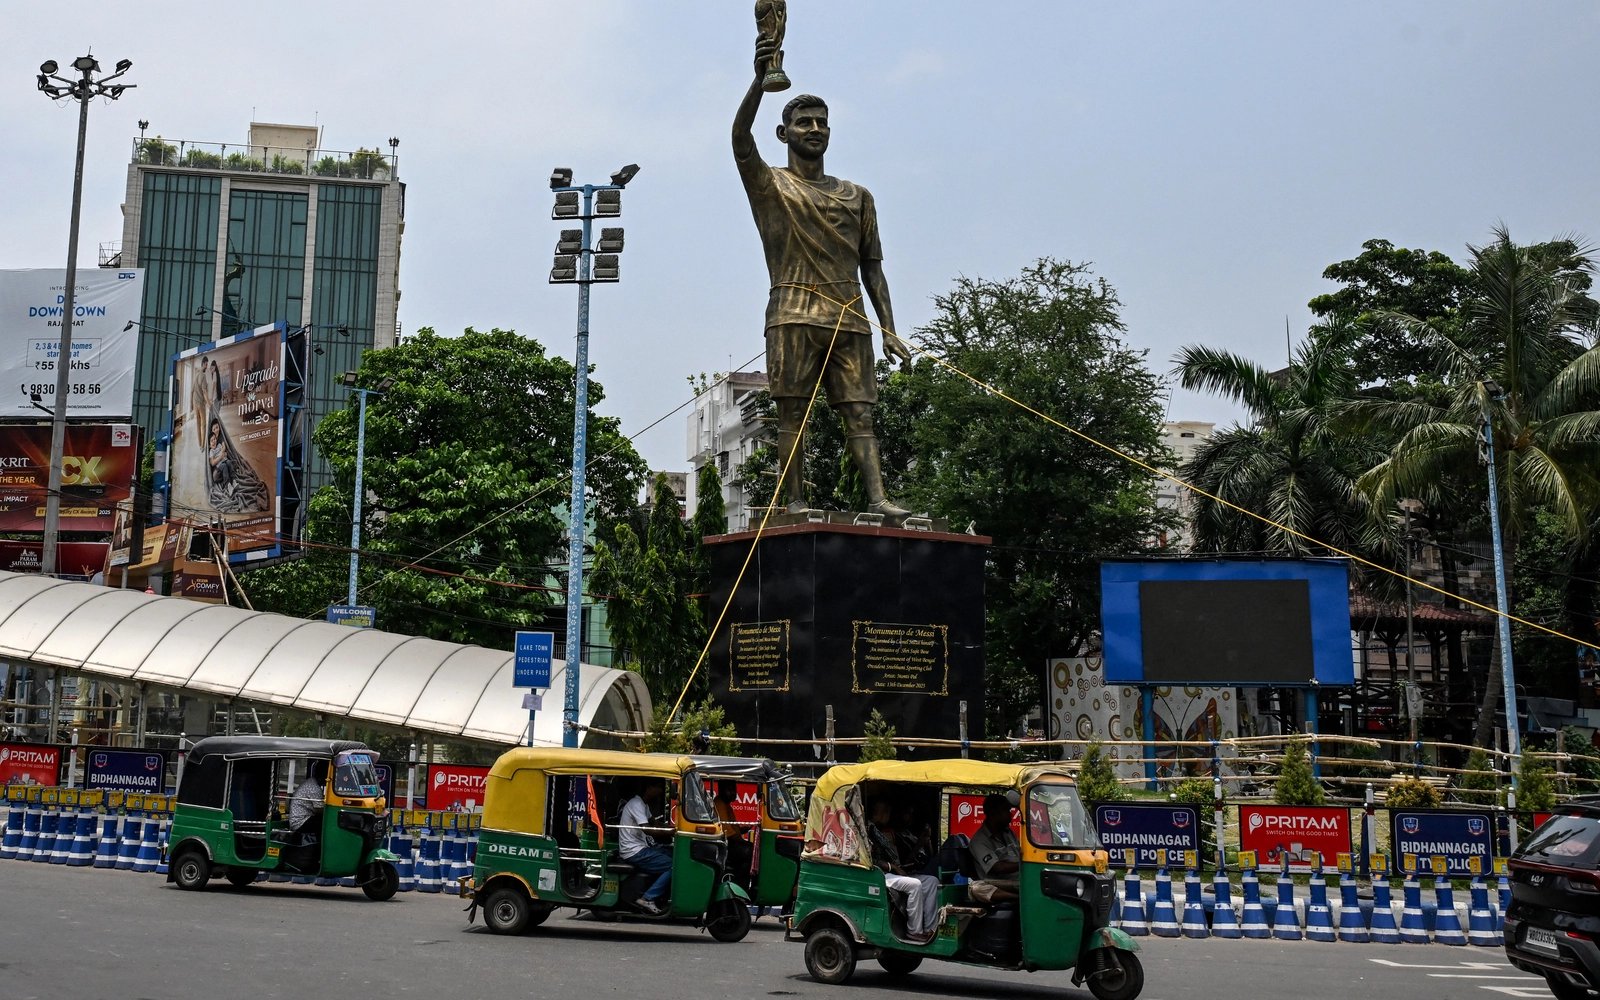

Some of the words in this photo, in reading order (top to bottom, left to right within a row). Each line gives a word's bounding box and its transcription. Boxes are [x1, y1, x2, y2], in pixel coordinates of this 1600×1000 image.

[72, 341, 93, 350] homes
[73, 350, 80, 358] at
[235, 361, 279, 394] Upgrade
[30, 383, 55, 395] 9830
[73, 383, 86, 395] 58
[88, 383, 101, 395] 56
[238, 396, 275, 417] morva
[60, 456, 103, 485] CX
[15, 476, 36, 484] YEAR
[195, 583, 220, 591] COMFY
[332, 608, 372, 616] WELCOME
[864, 626, 906, 637] Monumento
[905, 628, 915, 636] de
[915, 629, 936, 639] Messi
[518, 656, 549, 664] PEDESTRIAN
[535, 669, 549, 677] PASS
[9, 750, 55, 764] PRITAM
[90, 773, 157, 787] BIDHANNAGAR
[1265, 815, 1338, 830] PRITAM
[1101, 832, 1191, 847] BIDHANNAGAR
[488, 843, 541, 859] DREAM
[1140, 848, 1185, 861] POCE
[1401, 841, 1486, 855] BIDHANNAGAR
